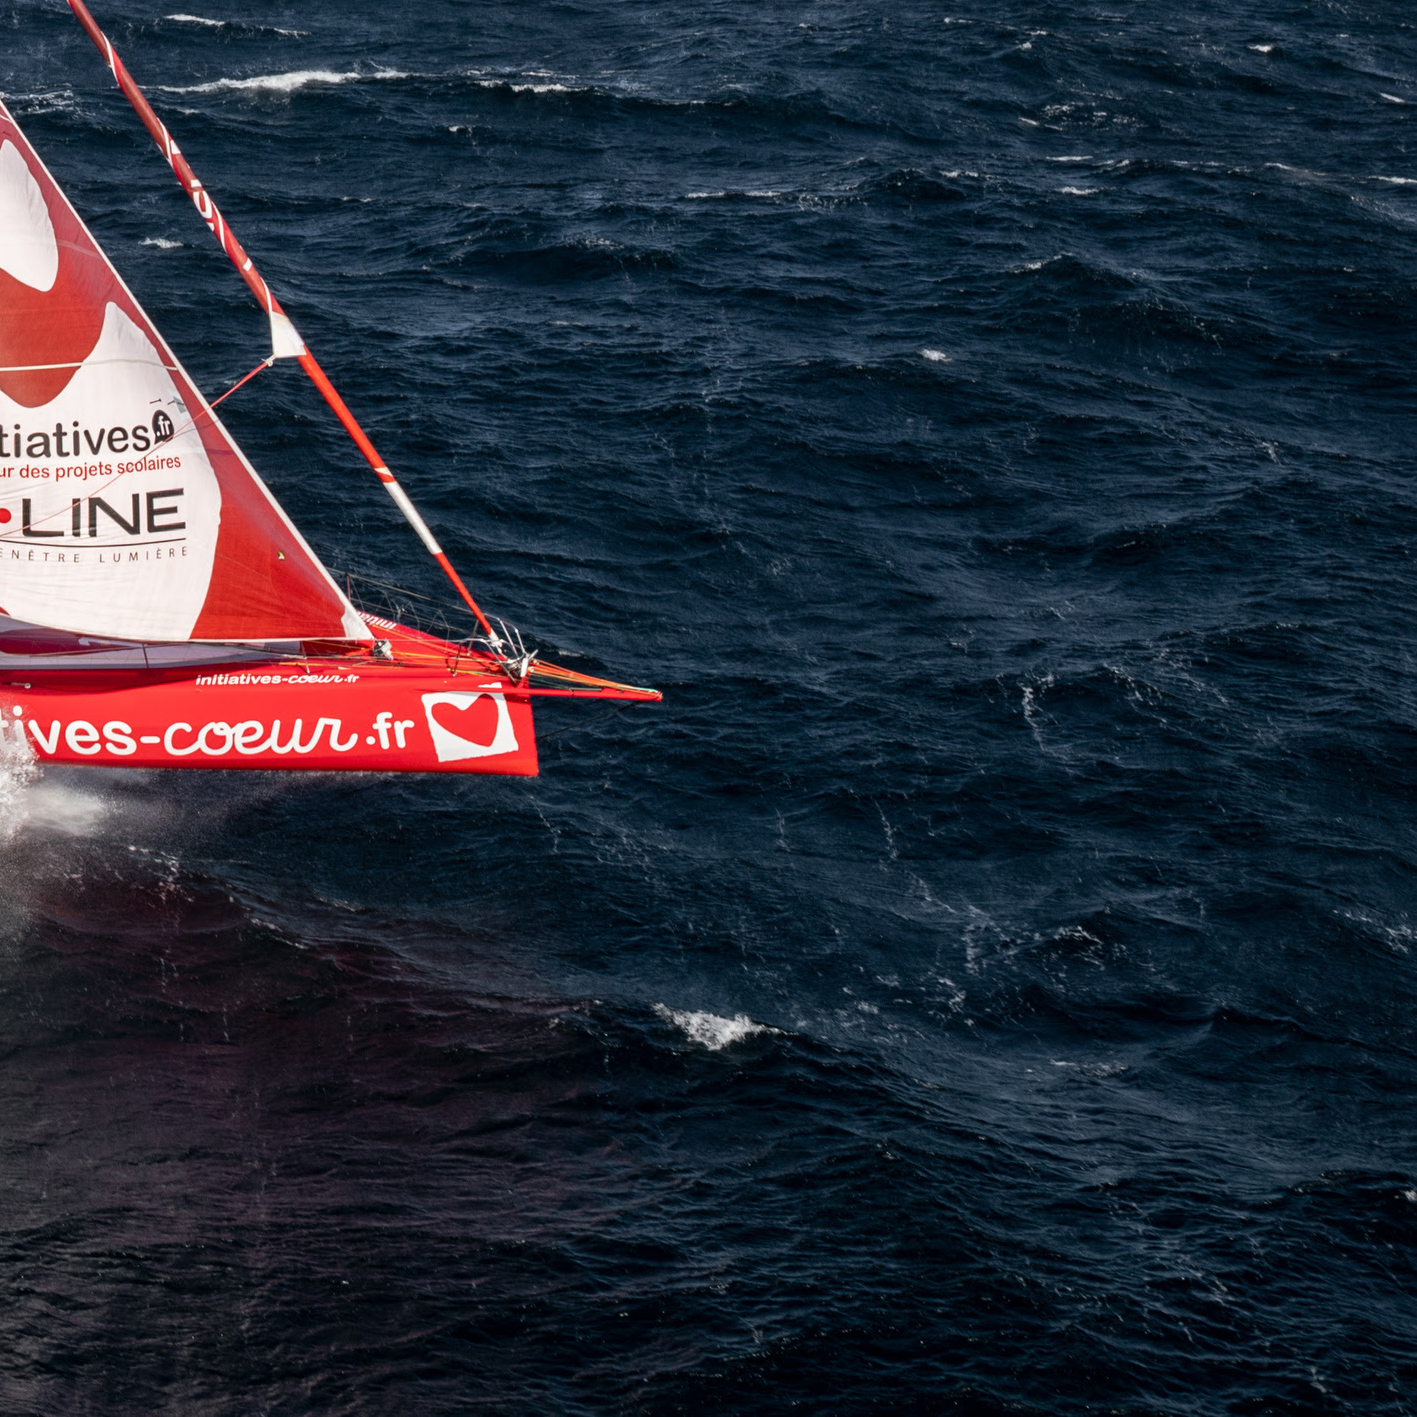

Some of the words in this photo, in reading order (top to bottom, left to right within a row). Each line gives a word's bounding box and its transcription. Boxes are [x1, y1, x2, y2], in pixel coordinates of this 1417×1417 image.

[18, 463, 51, 480] des
[55, 460, 113, 482] projets
[116, 454, 182, 476] scolaires
[98, 545, 189, 564] LUMIÈRE
